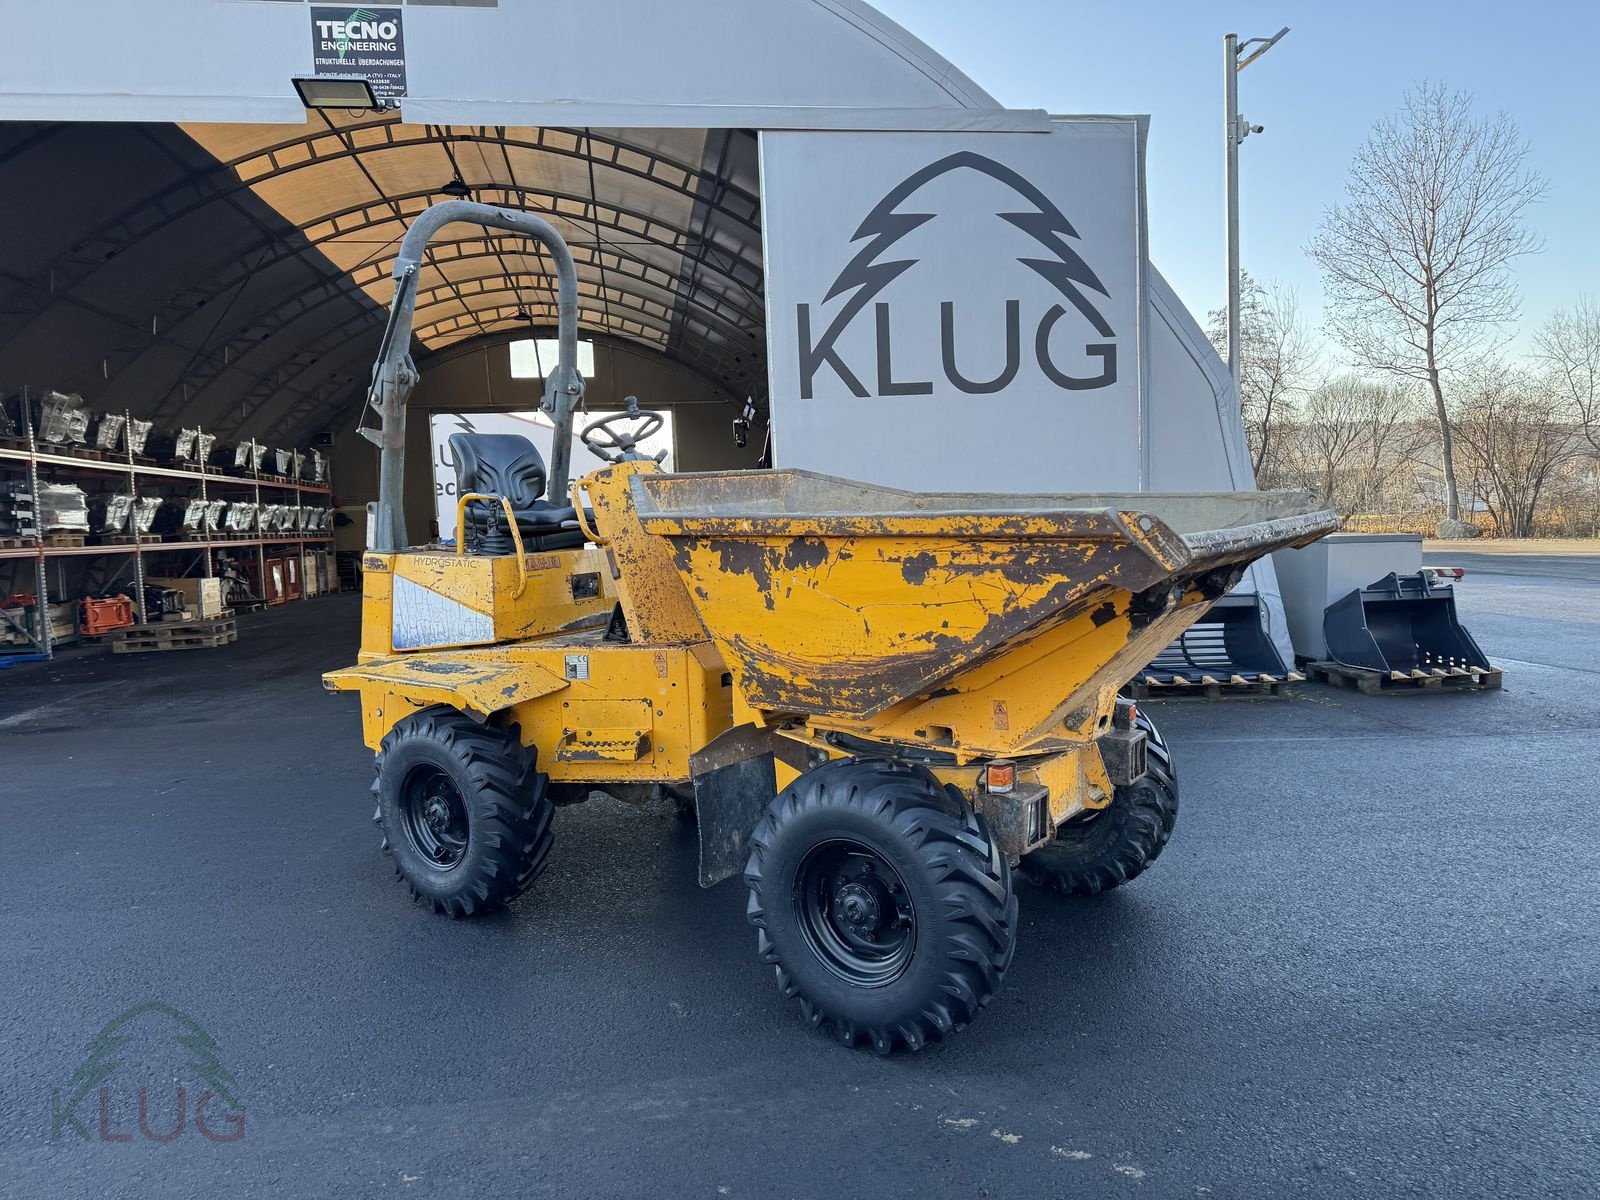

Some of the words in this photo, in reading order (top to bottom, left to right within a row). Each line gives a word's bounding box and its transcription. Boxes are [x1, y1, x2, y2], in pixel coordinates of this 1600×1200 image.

[321, 41, 397, 52] ENGINEERING
[315, 58, 356, 66] STRUKTURELLE
[797, 300, 1117, 399] KLUG
[413, 557, 477, 569] HYDROSTATIC
